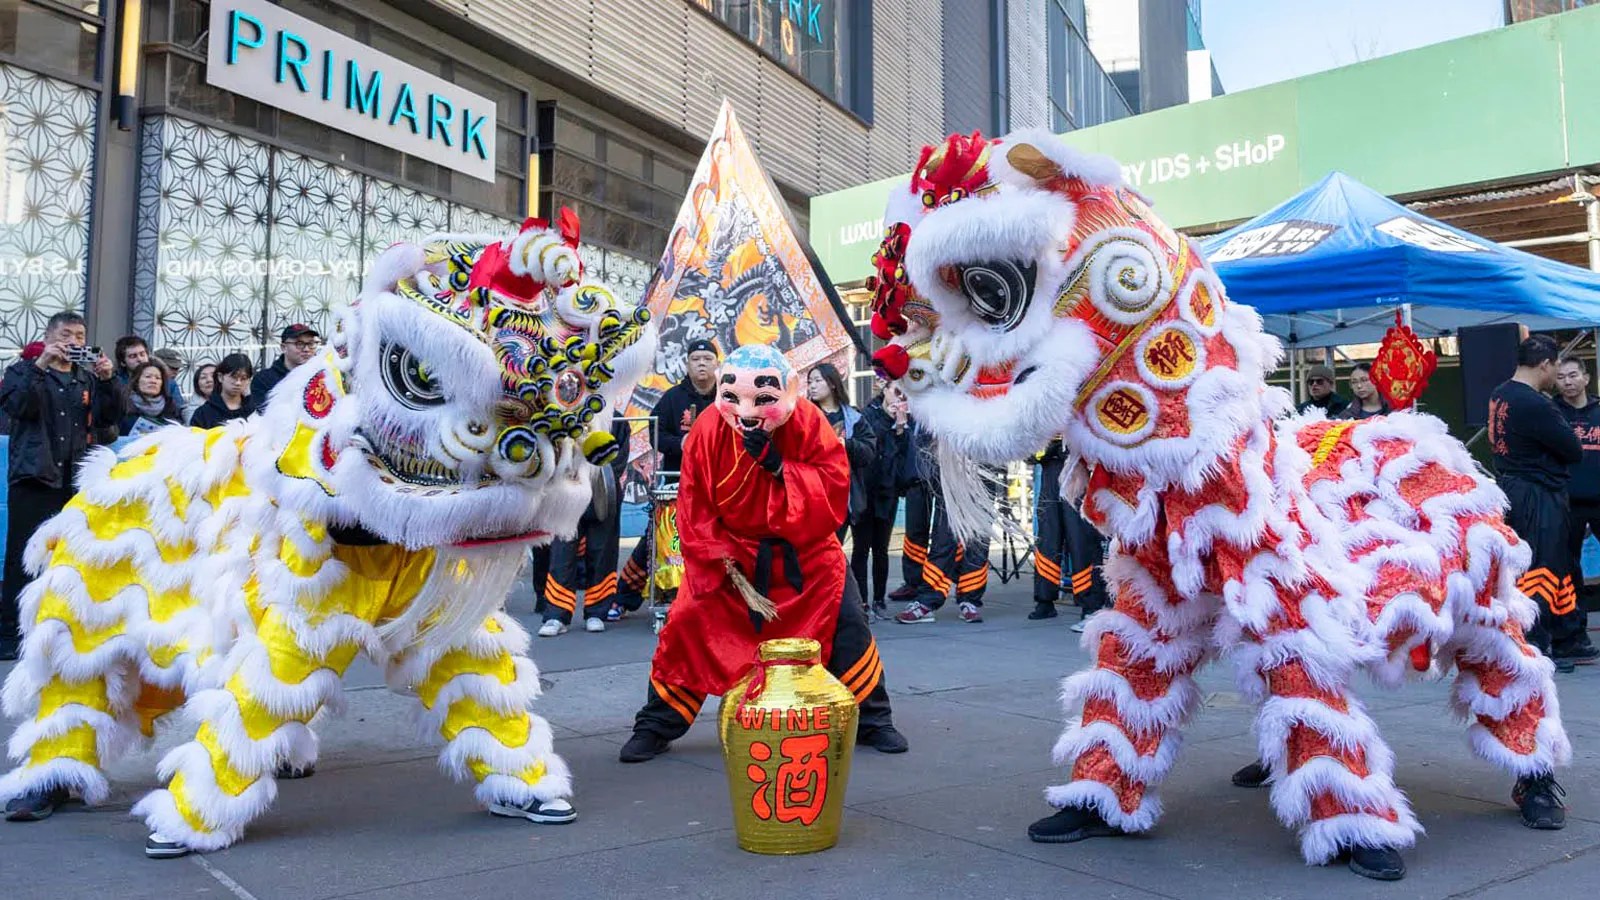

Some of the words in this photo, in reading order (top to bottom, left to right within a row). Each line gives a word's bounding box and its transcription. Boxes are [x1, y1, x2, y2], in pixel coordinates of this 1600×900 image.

[227, 10, 489, 160] PRIMARK
[1147, 153, 1191, 184] JDS
[1215, 134, 1285, 171] SHoP
[841, 217, 884, 245] LUXU
[741, 707, 830, 730] WINE
[747, 733, 830, 826] 酒
